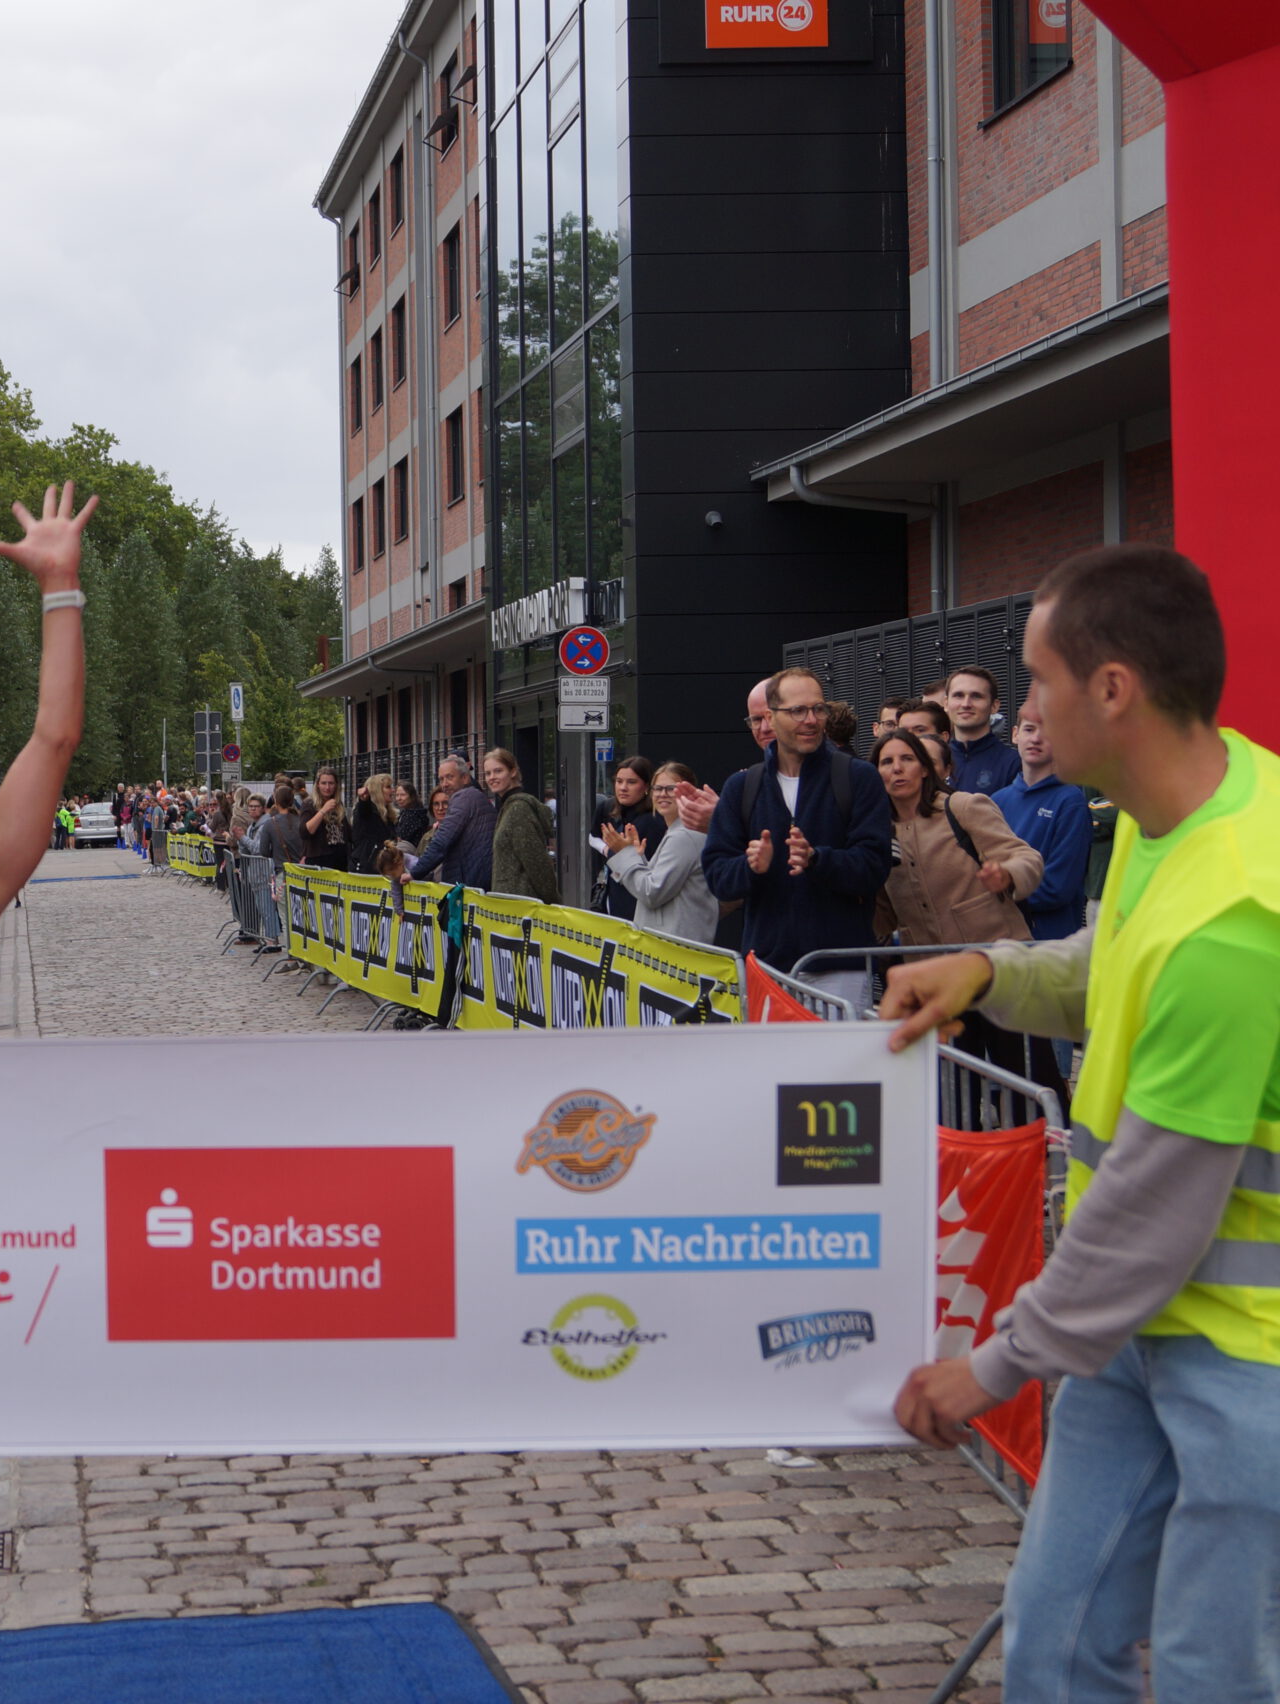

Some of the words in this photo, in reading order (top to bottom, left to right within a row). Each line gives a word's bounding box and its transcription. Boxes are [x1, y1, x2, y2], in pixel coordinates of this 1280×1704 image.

[720, 6, 774, 23] RUHR
[783, 5, 806, 21] 24
[211, 1217, 380, 1254] Sparkasse
[525, 1226, 620, 1264] Ruhr
[631, 1222, 871, 1262] Nachrichten
[211, 1259, 380, 1290] Dortmund
